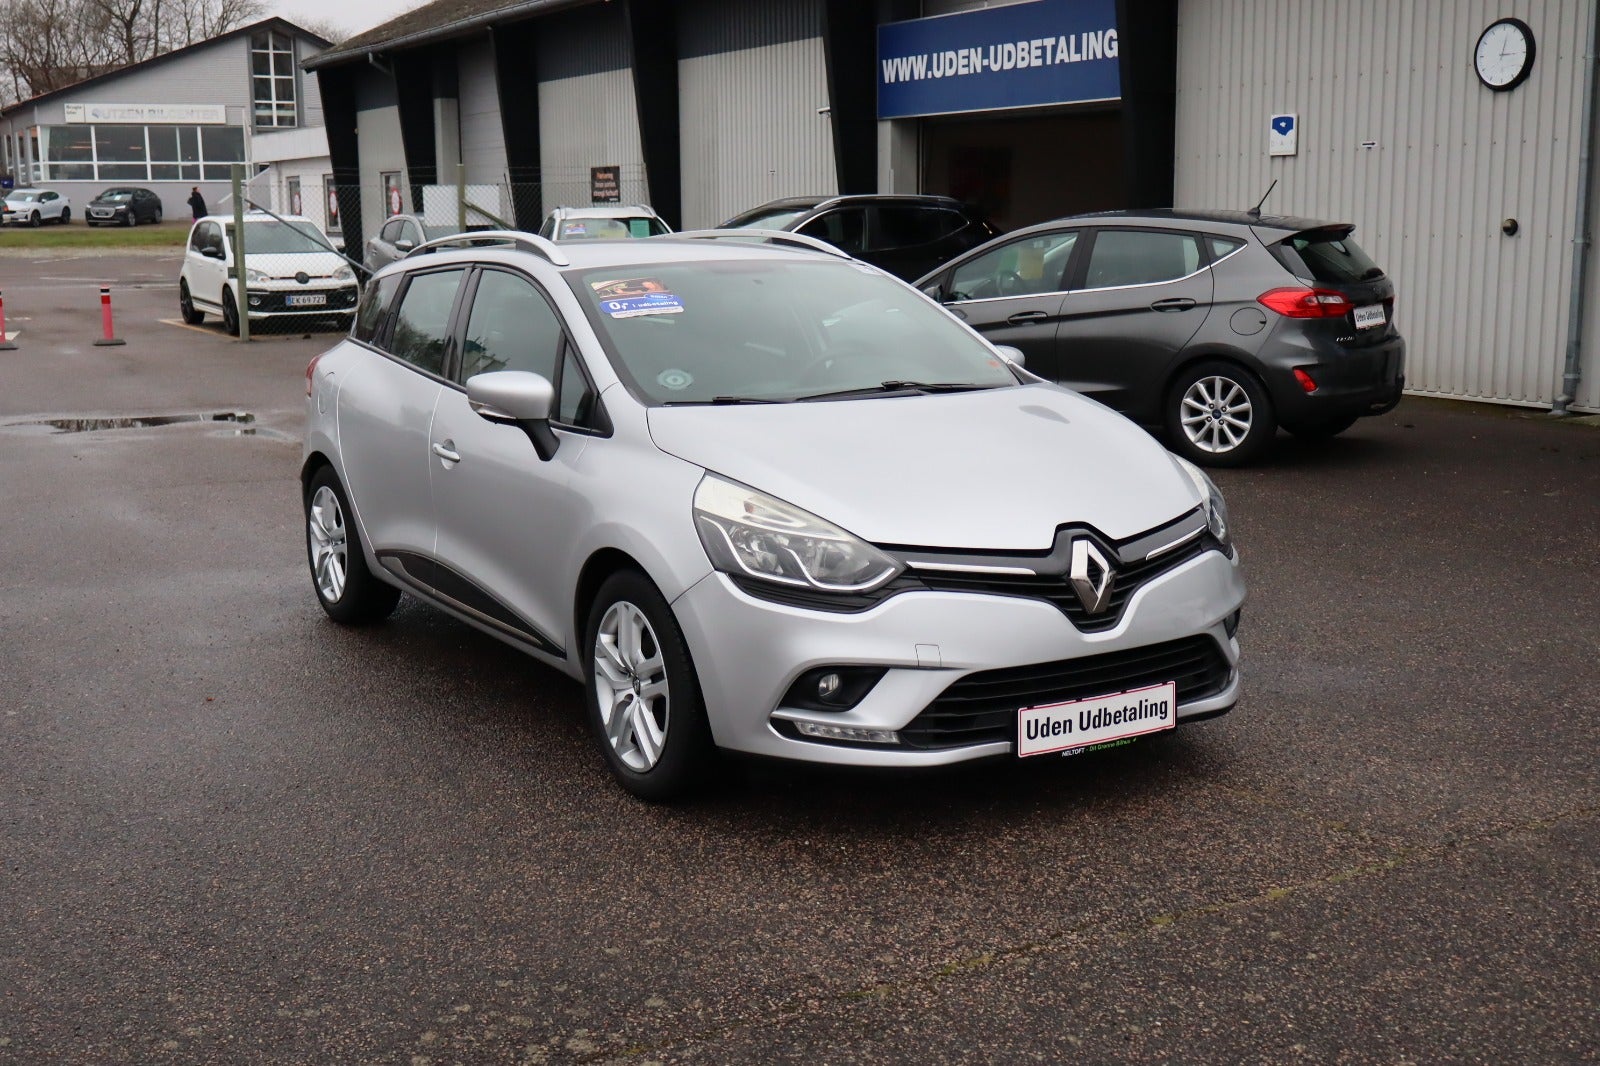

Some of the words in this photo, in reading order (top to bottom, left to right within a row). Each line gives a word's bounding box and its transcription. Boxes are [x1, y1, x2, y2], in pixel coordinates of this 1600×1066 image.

[882, 28, 1119, 84] WWW.UDEN-UDBETALING
[302, 296, 311, 304] 69
[1026, 716, 1073, 741] Uden
[1079, 698, 1168, 732] Udbetaling
[1061, 747, 1086, 758] NELTOFT
